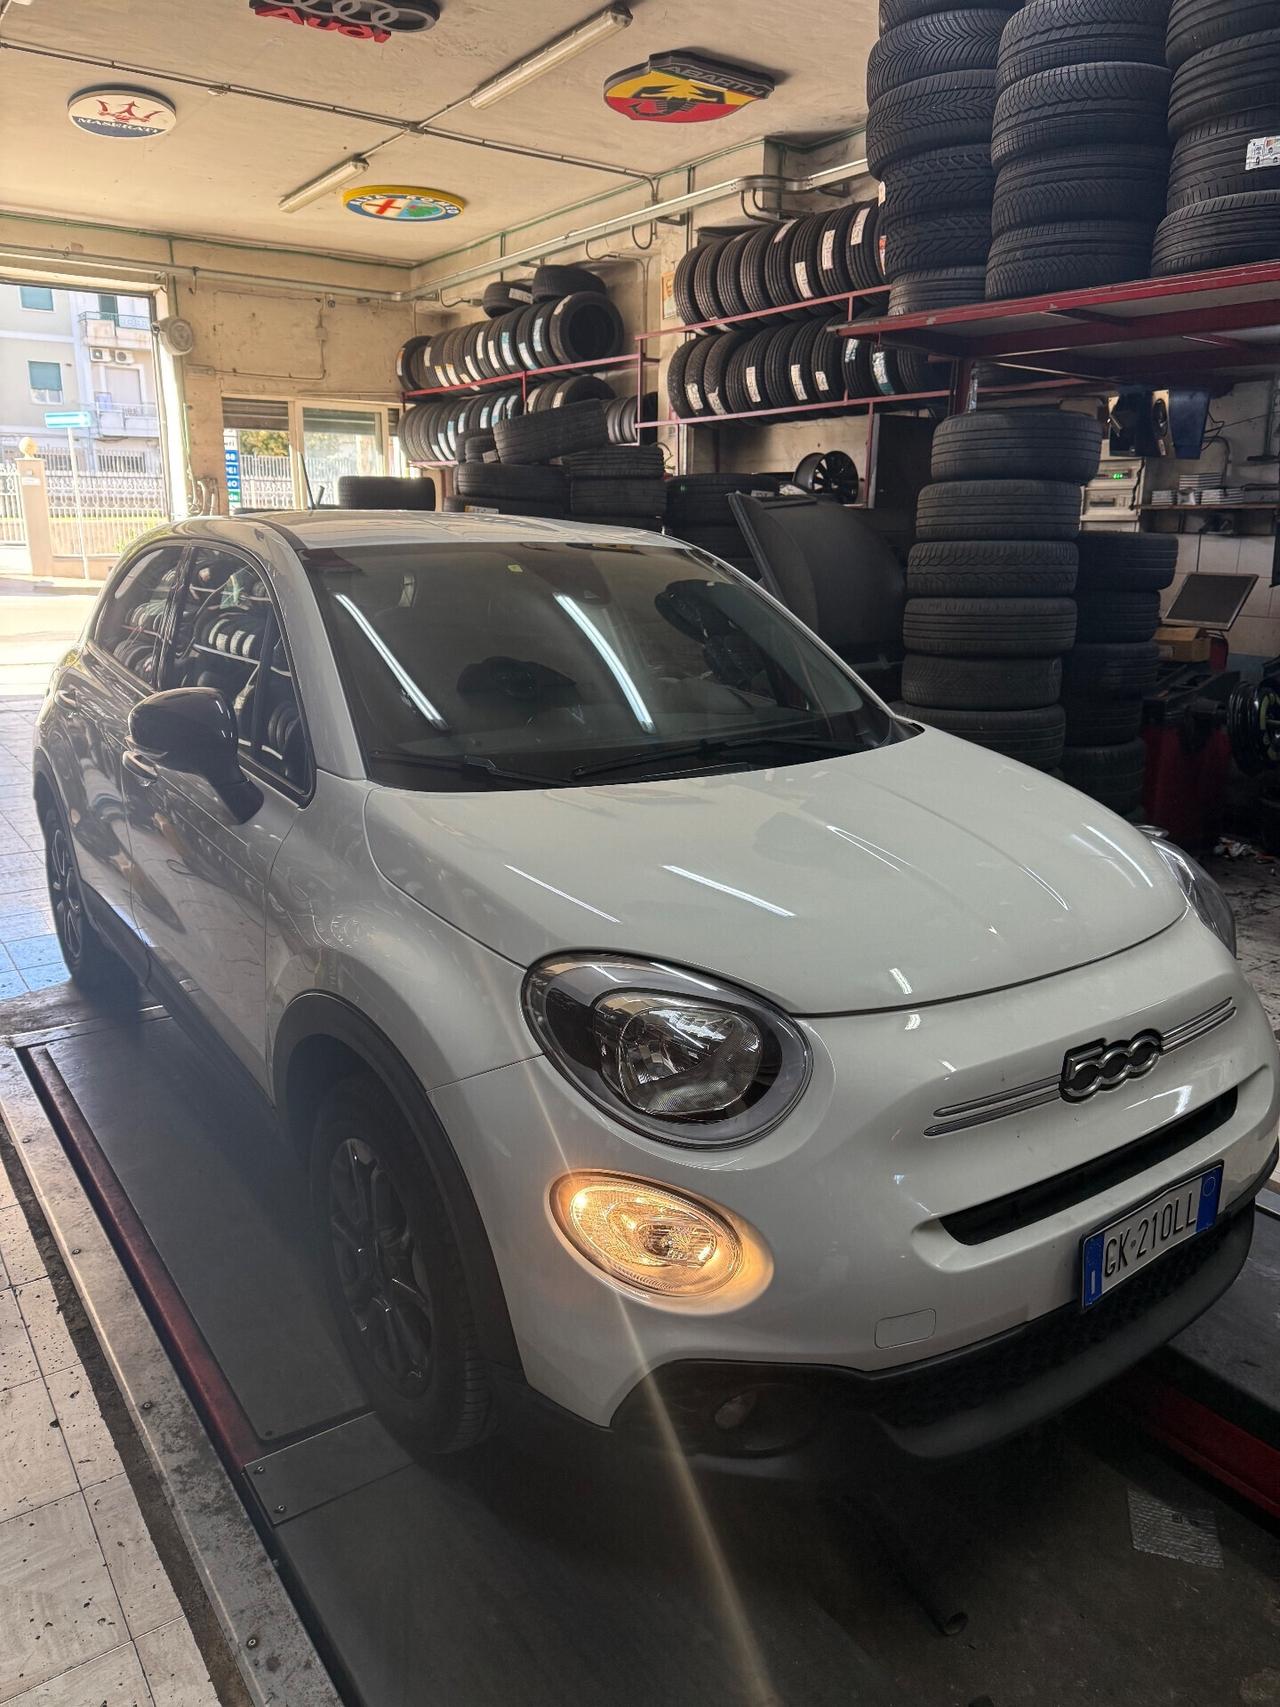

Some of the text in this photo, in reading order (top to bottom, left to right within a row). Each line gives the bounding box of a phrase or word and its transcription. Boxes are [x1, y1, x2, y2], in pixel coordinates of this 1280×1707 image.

[669, 66, 765, 96] ABARTH
[78, 117, 159, 133] MASERATI
[1061, 1028, 1162, 1104] 500
